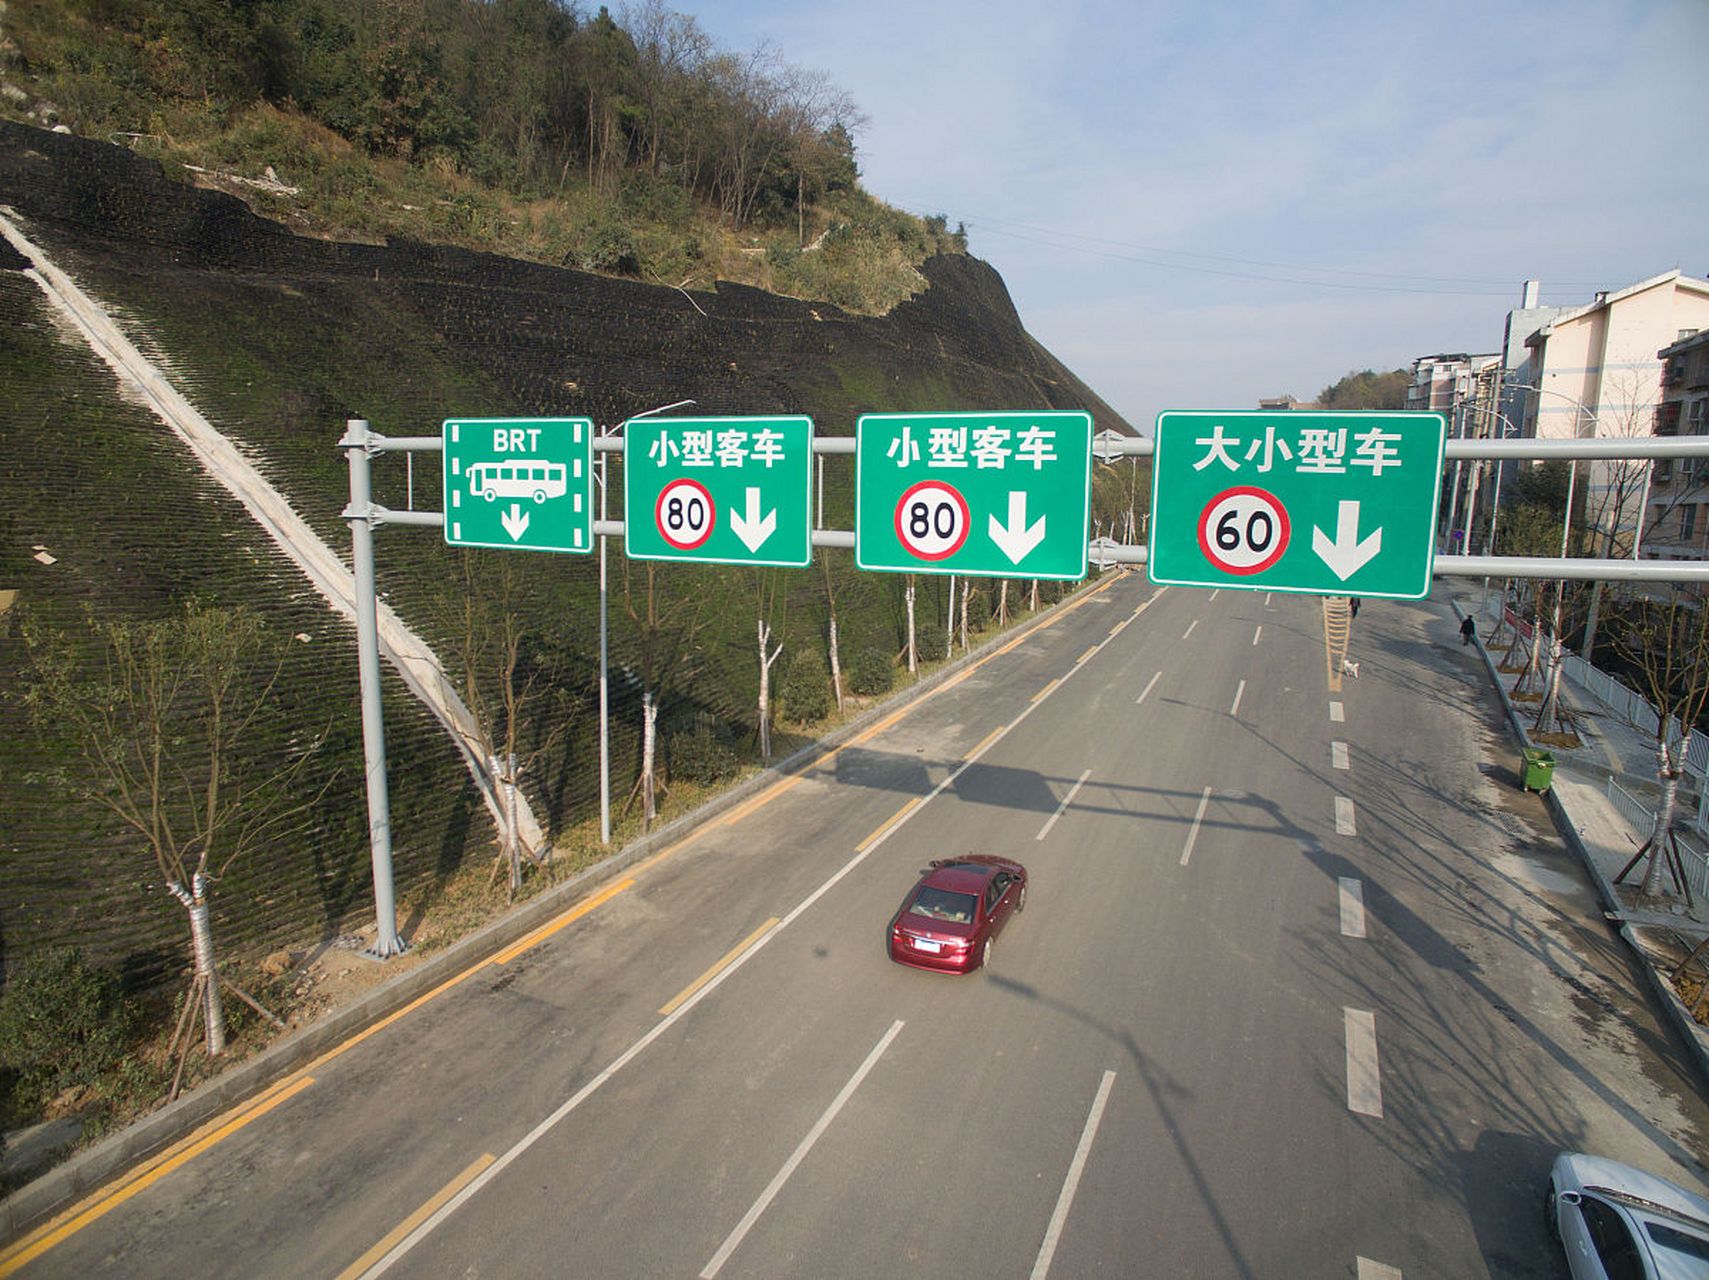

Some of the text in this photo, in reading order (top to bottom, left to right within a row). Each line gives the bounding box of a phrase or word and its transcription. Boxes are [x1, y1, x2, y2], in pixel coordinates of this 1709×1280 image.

[493, 429, 542, 452] BRT
[649, 428, 785, 468] 小型客车
[887, 426, 1058, 470] 小型客车
[1192, 426, 1403, 476] 大小型车
[667, 497, 705, 531] 80
[910, 502, 955, 539] 80
[1216, 510, 1273, 553] 60
